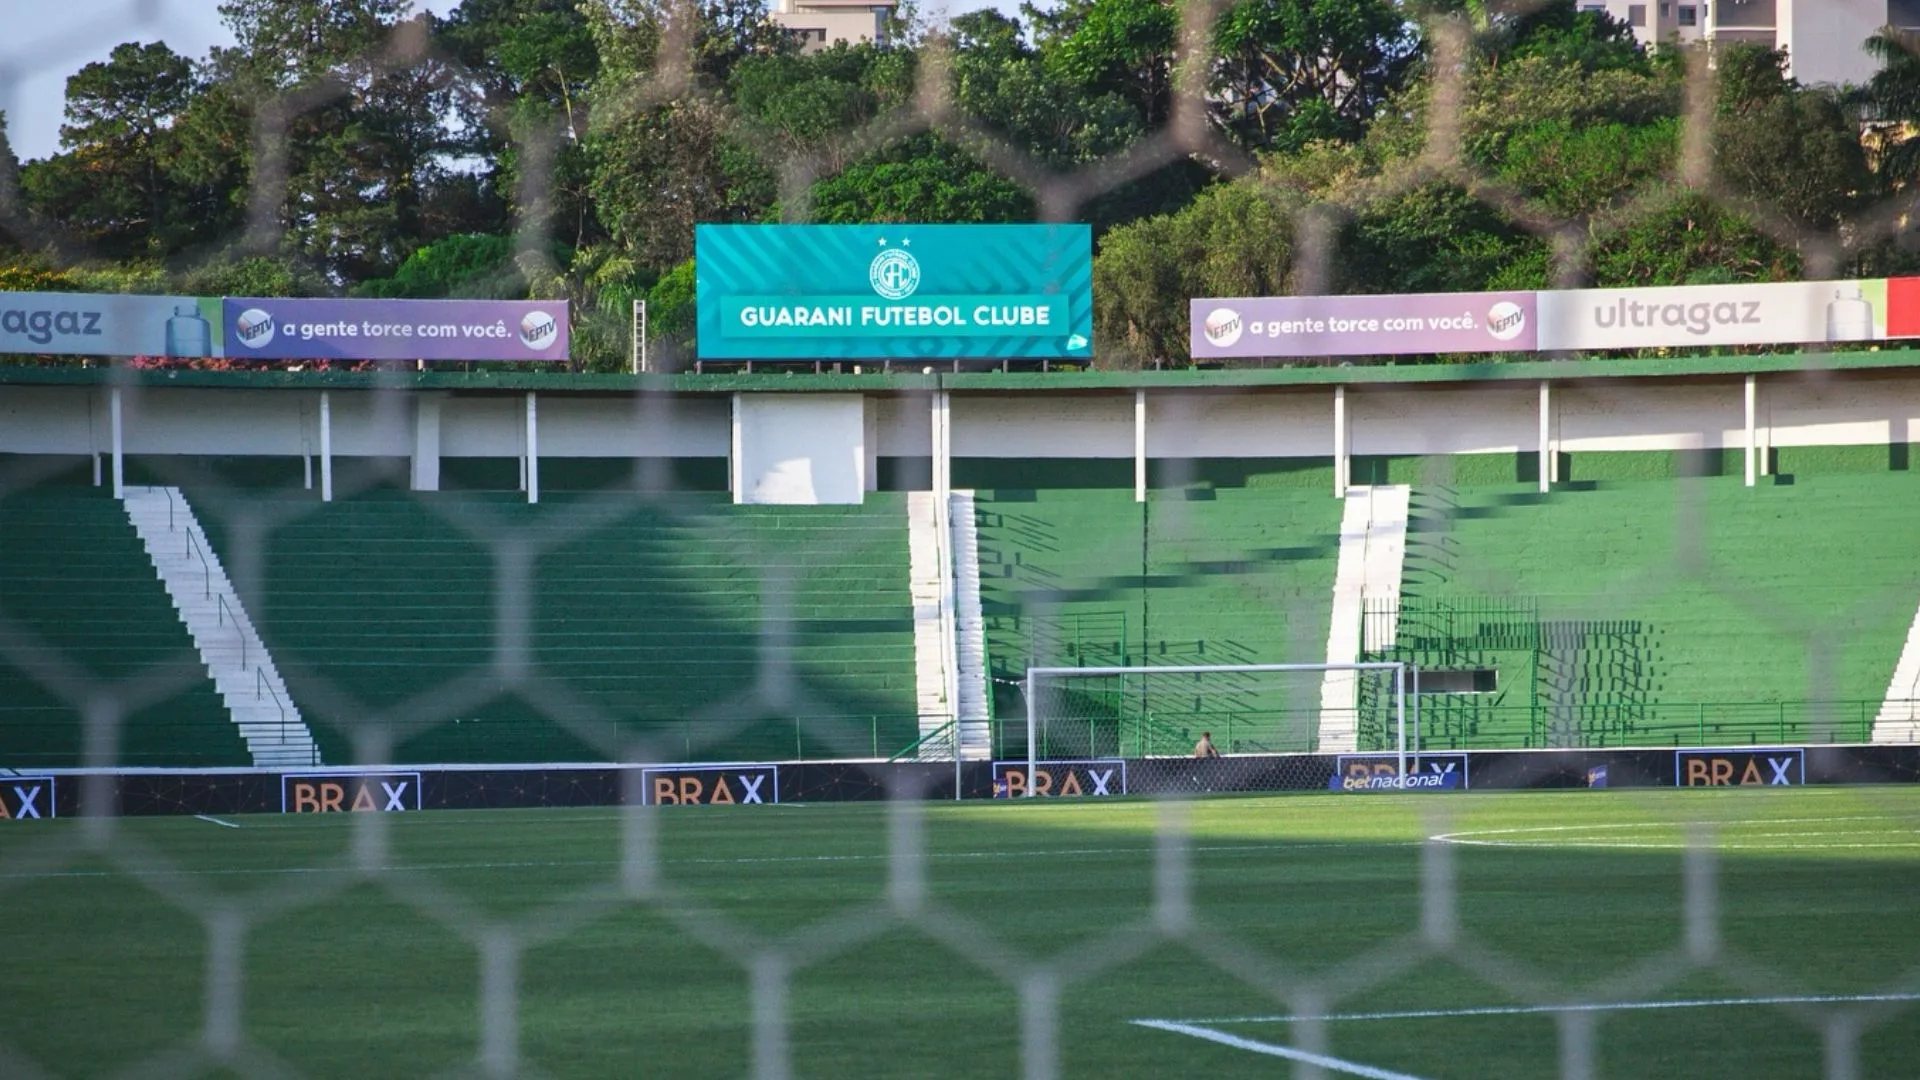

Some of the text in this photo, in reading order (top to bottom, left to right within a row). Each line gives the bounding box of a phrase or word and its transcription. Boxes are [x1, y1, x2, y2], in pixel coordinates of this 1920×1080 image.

[0, 309, 102, 344] agaz
[283, 319, 512, 340] a gente torce com você.
[740, 305, 1050, 327] GUARANI FUTEBOL CLUBE
[1250, 312, 1478, 338] a gente torce com você.
[1594, 298, 1761, 335] ultragaz
[1006, 769, 1113, 797] BRAX
[1688, 757, 1792, 786] BRAX
[295, 781, 408, 813] BRAX
[654, 775, 765, 804] BRAX
